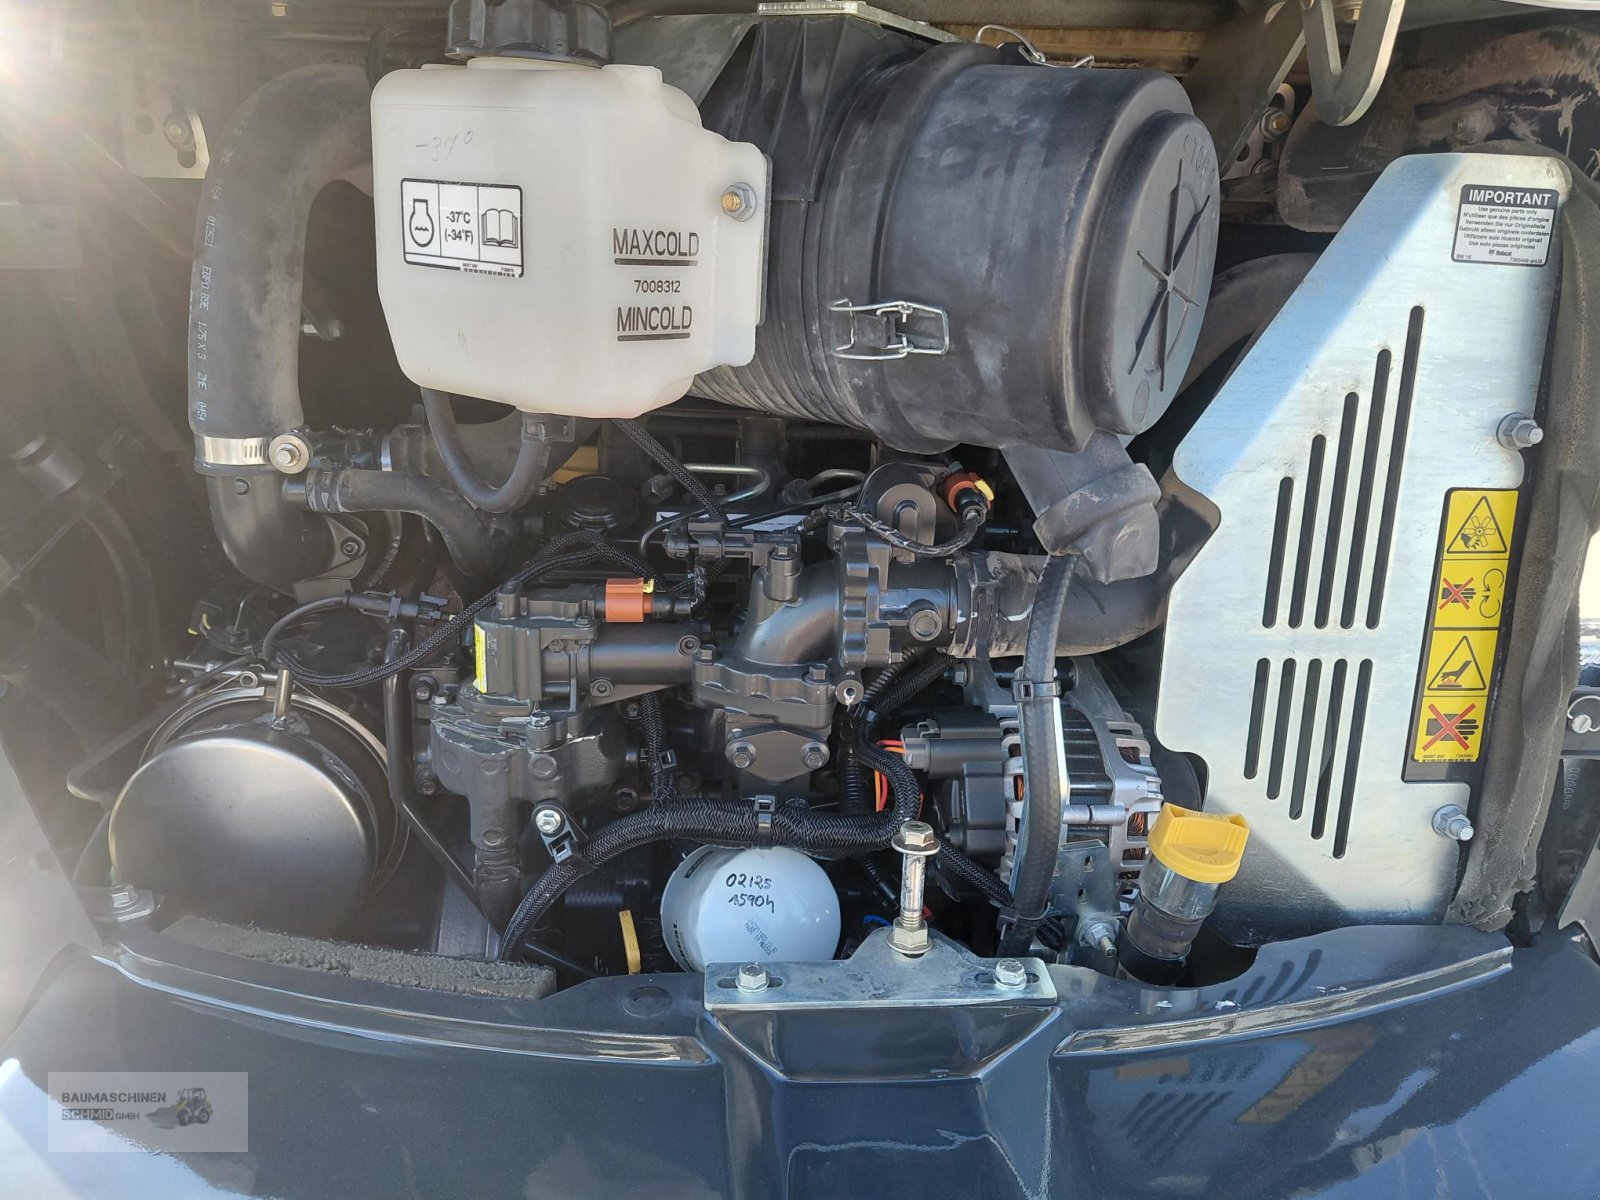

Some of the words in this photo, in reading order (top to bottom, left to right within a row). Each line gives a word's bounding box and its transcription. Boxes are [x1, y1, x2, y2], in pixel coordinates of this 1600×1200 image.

[1468, 189, 1552, 207] IMPORTANT
[446, 211, 471, 224] -37°C
[444, 228, 473, 245] (-34°F)
[613, 228, 699, 257] MAXCOLD
[634, 280, 680, 293] 7008312
[617, 306, 692, 332] MINCOLD
